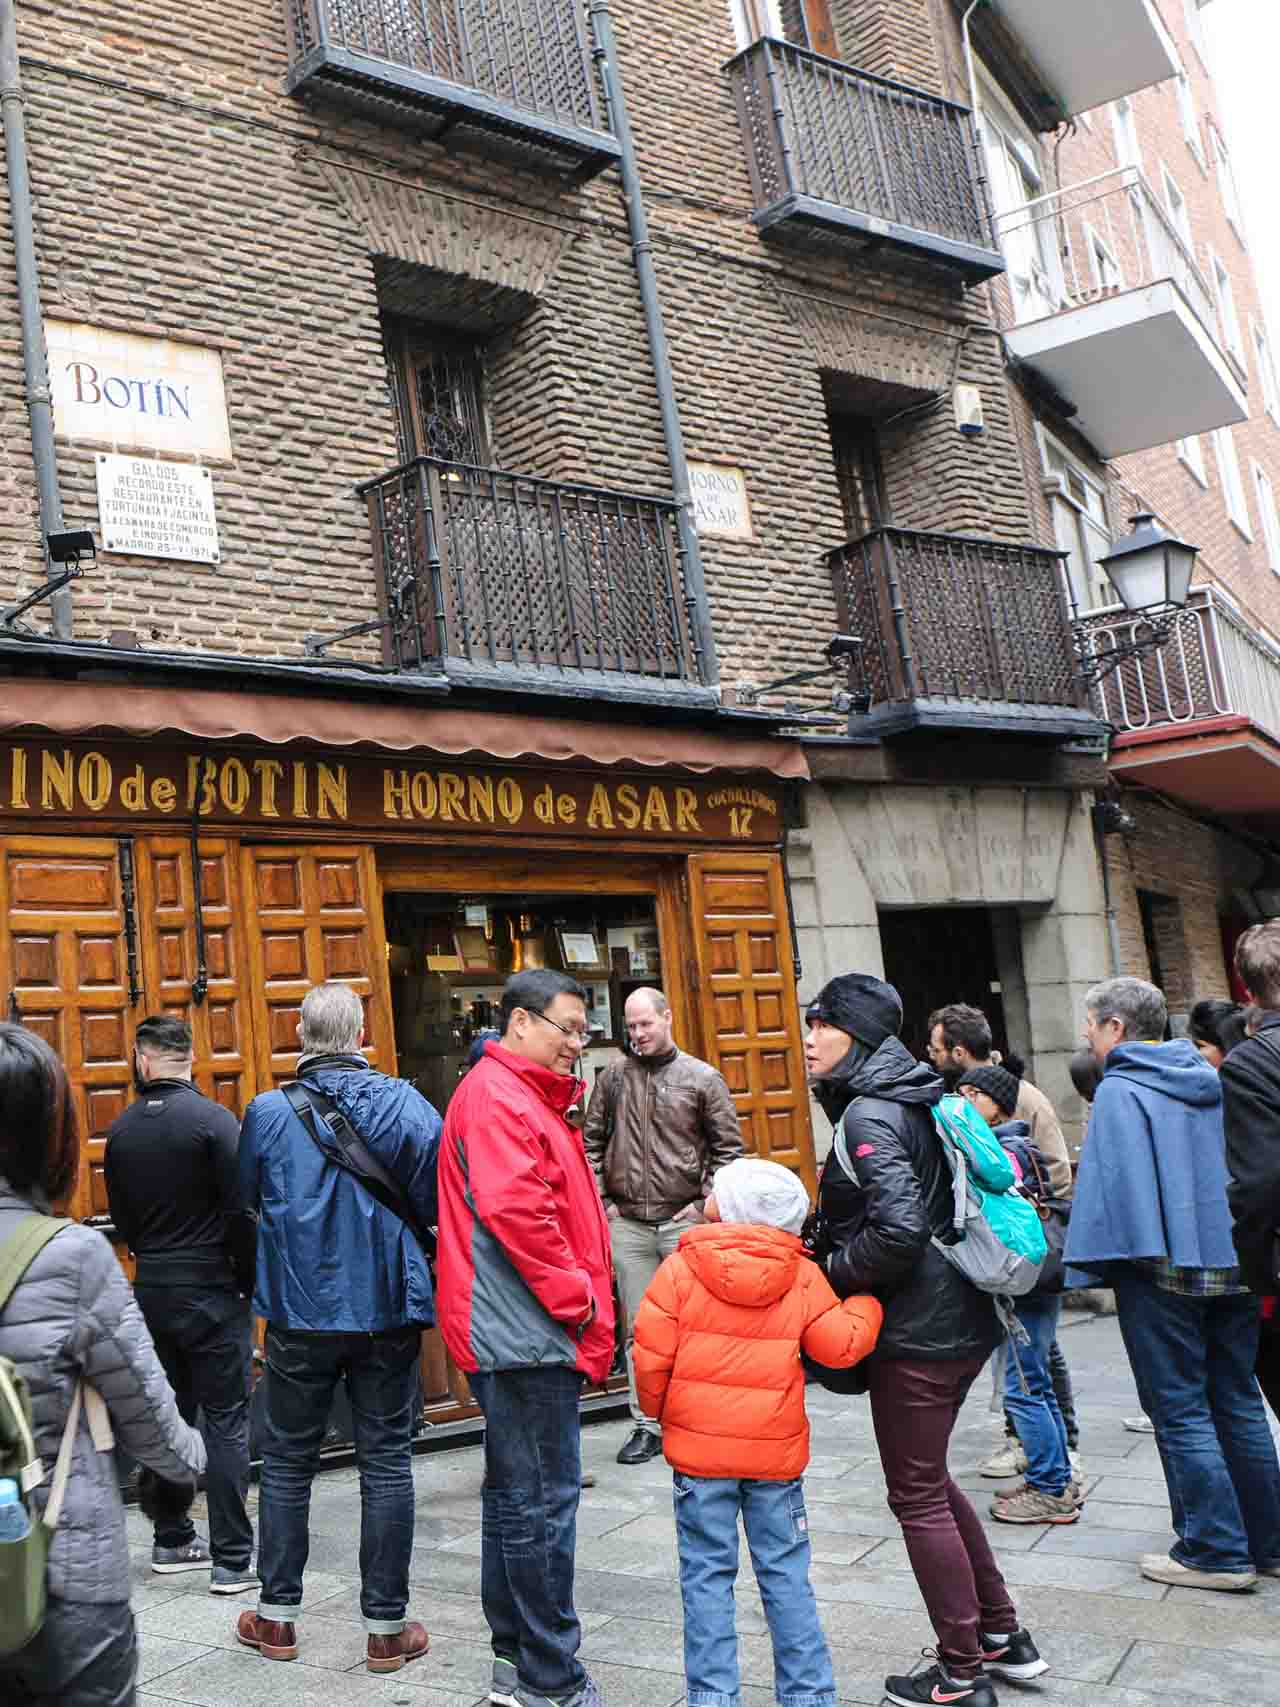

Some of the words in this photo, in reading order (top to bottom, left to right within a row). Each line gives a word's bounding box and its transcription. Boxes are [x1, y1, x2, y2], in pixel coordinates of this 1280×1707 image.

[113, 487, 185, 506] RESTAURANTE
[167, 482, 194, 496] ESTE
[120, 764, 177, 813] de
[383, 769, 523, 825] HORNO
[533, 784, 577, 825] de
[587, 784, 704, 832] ASAR
